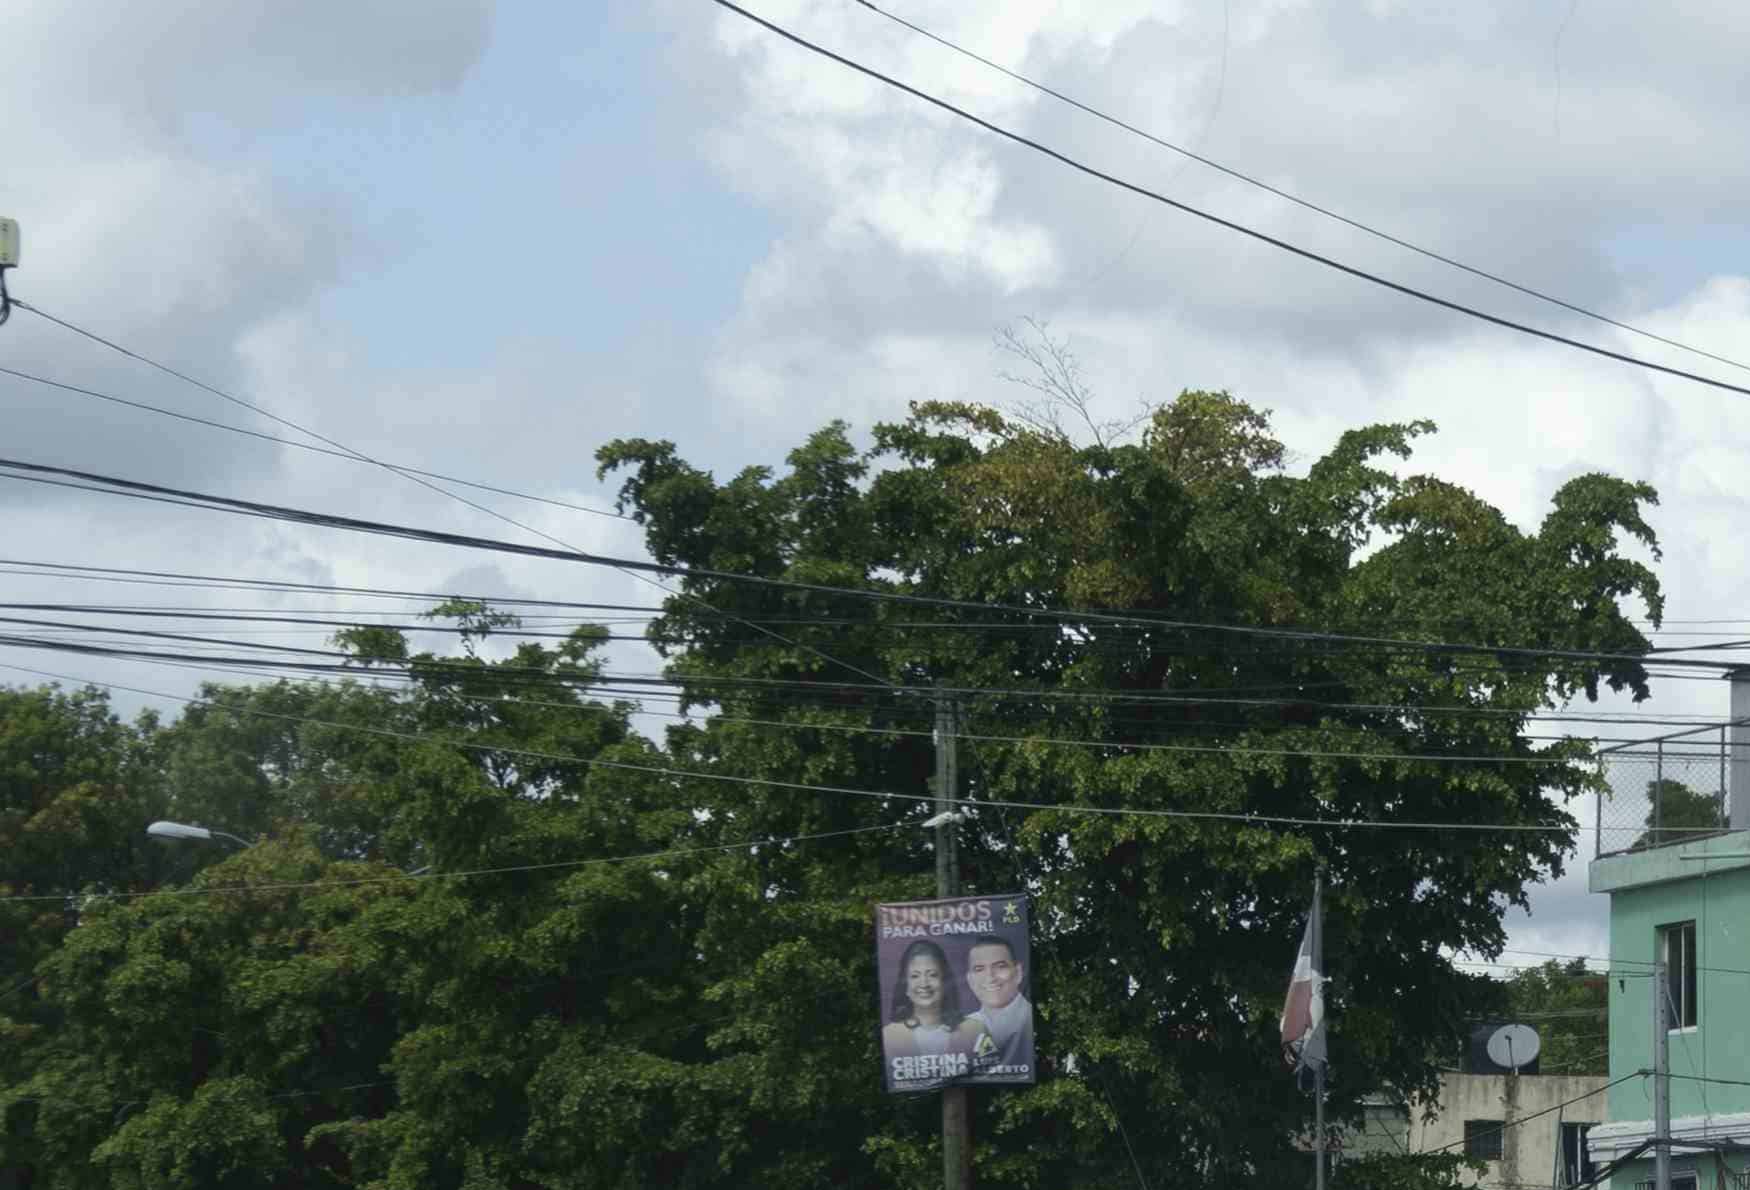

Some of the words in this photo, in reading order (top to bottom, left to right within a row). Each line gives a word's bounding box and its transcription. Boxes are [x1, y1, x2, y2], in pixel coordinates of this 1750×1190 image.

[883, 926, 928, 939] PARA
[930, 920, 993, 936] GANAR!
[892, 1052, 968, 1069] CRISTINA
